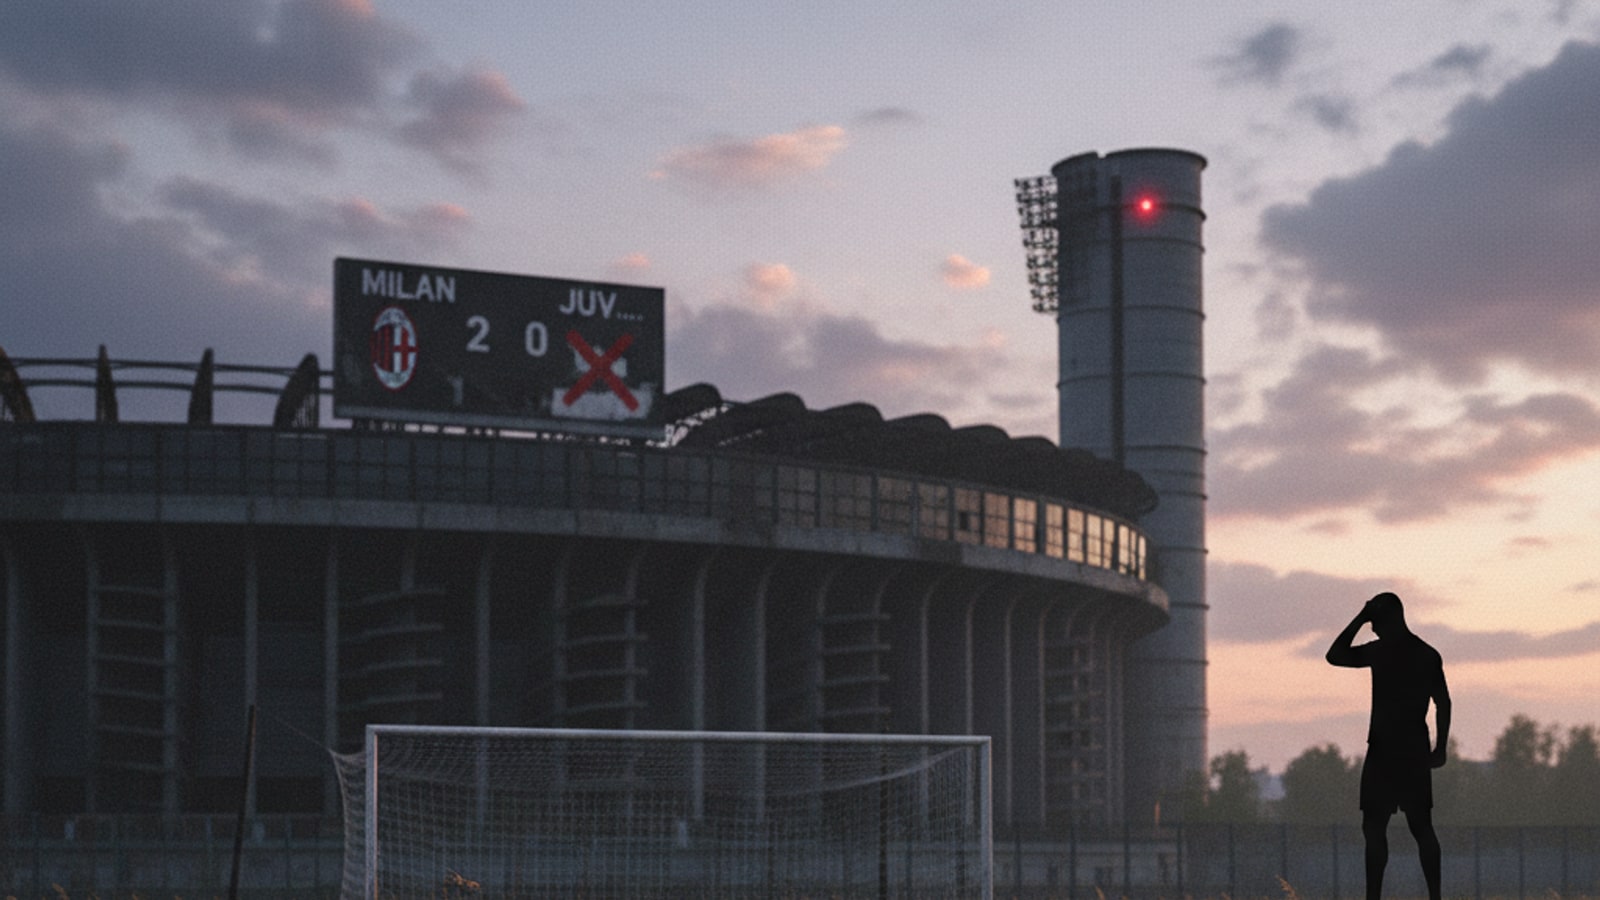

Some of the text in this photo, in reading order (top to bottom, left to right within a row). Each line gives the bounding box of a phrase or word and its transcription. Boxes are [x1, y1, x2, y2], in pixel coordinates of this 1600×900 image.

[362, 267, 456, 303] MILAN
[466, 315, 549, 357] 2 0
